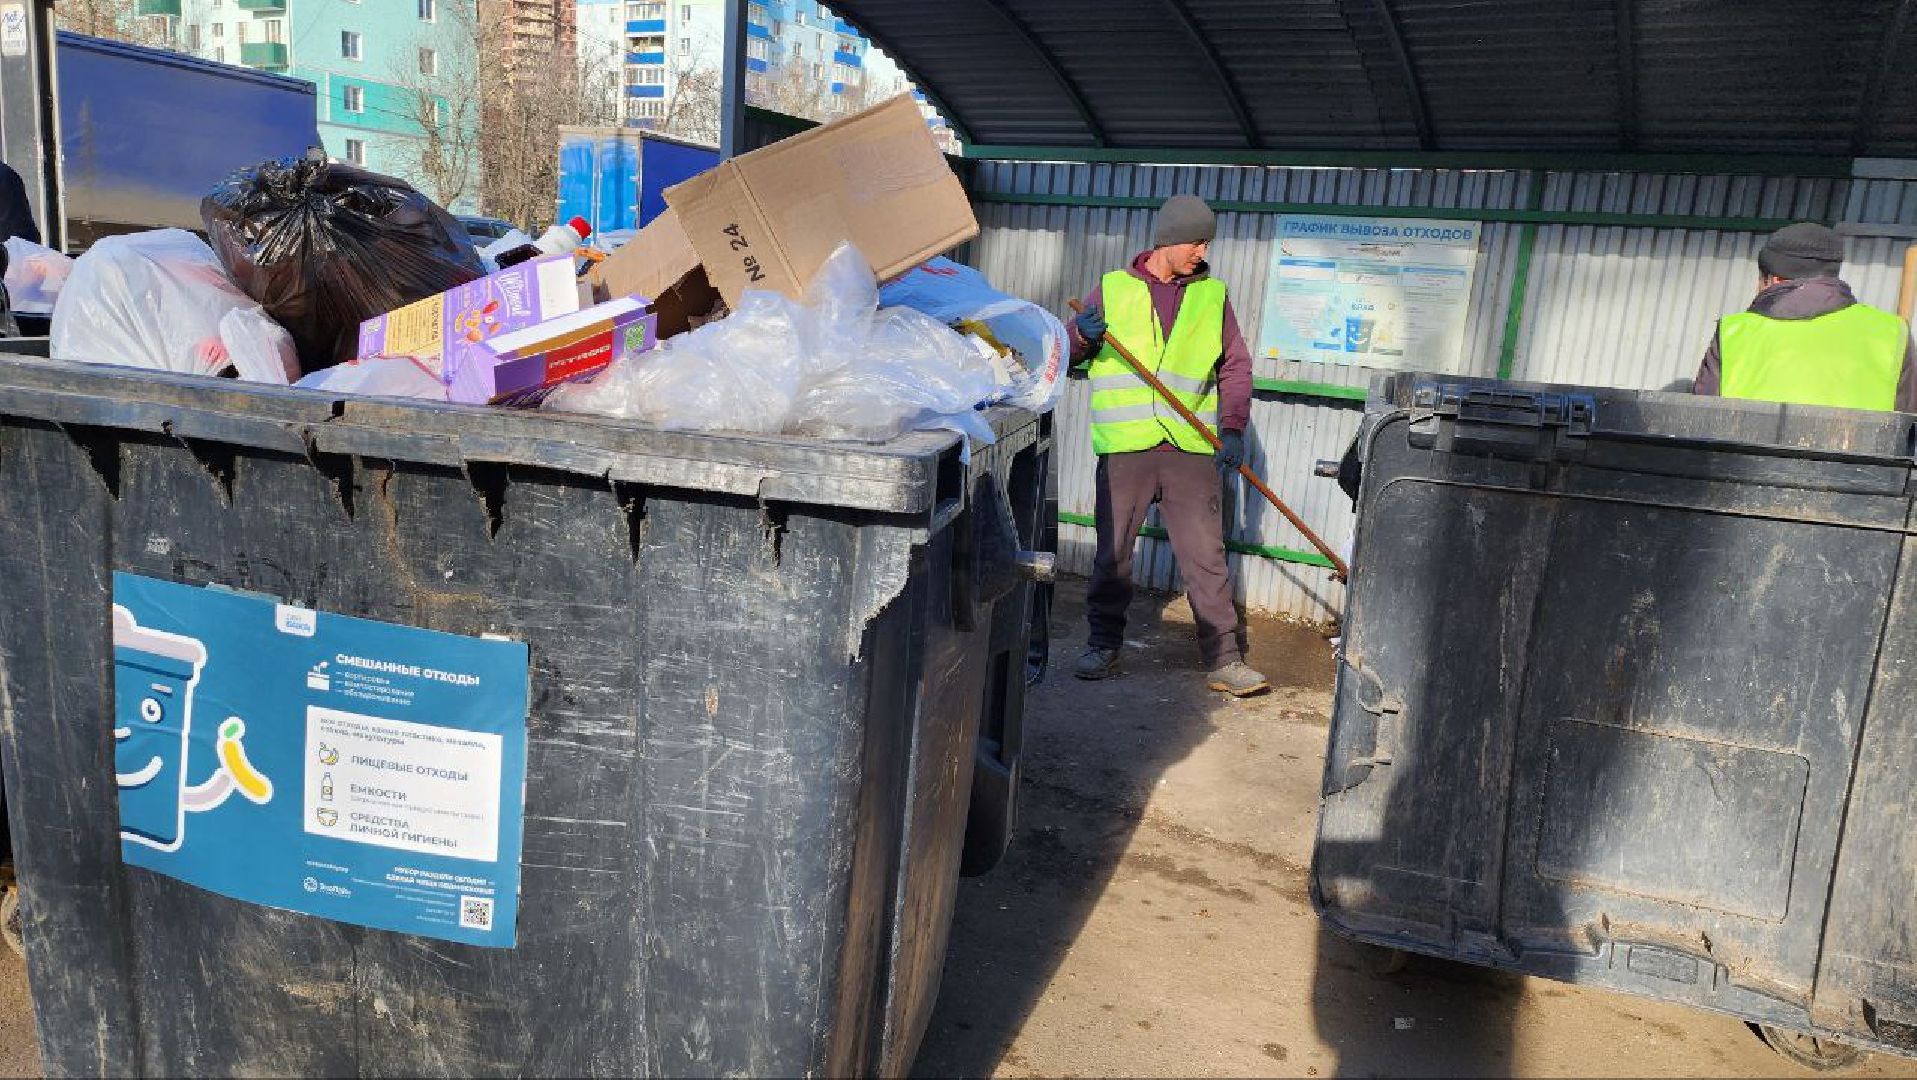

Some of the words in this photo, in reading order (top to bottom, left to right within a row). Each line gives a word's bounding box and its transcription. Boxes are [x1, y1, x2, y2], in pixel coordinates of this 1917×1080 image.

[723, 223, 748, 251] 24
[1284, 221, 1337, 234] ГРАФИК
[1341, 223, 1399, 236] ВЫВОЗА
[1403, 226, 1473, 241] ОТХОДОВ
[336, 653, 421, 678] СМЕШАННЫЕ
[423, 669, 480, 687] ОТХОДЫ
[351, 755, 414, 774] ПИЩЕВЫЕ
[416, 765, 468, 782] ОТХОДЫ
[350, 783, 408, 801] ЕМКОСТИ
[350, 812, 409, 829] СРЕДСТВА
[350, 824, 399, 839] ЛИЧНОЙ
[401, 831, 458, 848] ГИГИЕНЫ
